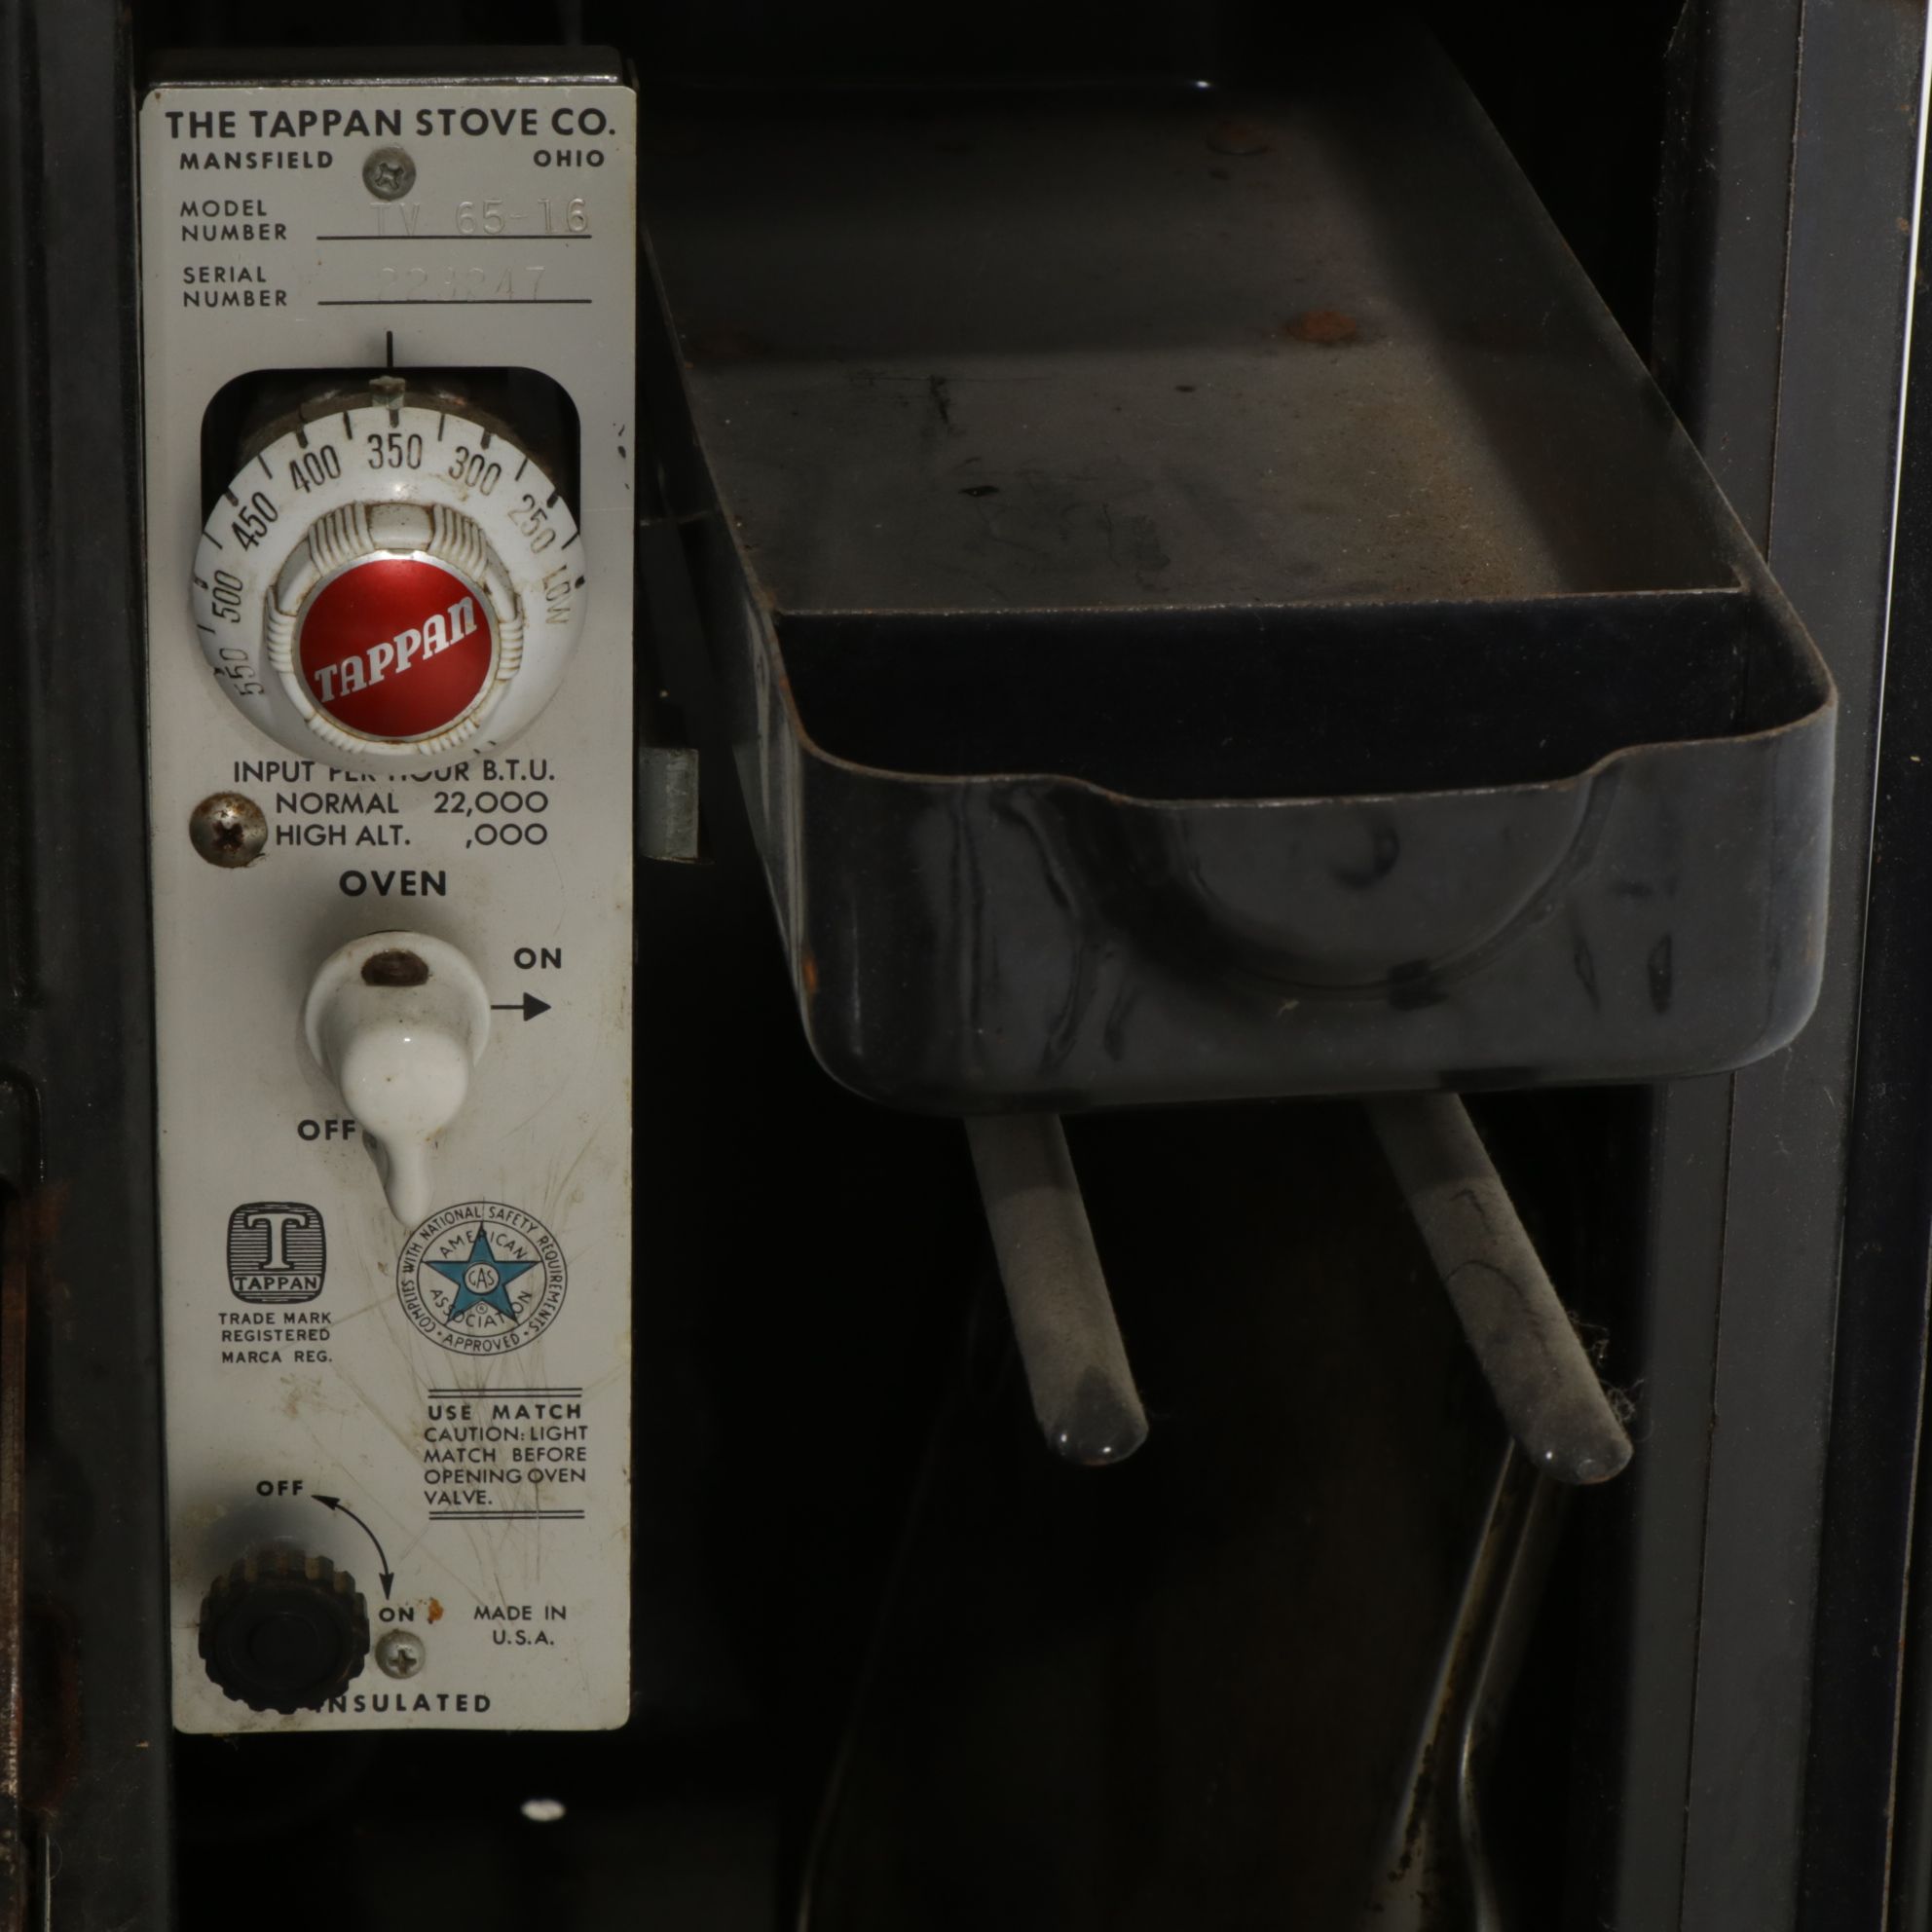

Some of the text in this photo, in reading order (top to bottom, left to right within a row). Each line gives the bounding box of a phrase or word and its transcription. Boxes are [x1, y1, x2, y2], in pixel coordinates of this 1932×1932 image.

[165, 107, 615, 139] THE TAPPAN STOVE CO.
[179, 149, 605, 170] MANSFIELD OHIO
[179, 199, 267, 218] MODEL
[181, 198, 590, 242] NUMBER TV 65-16
[183, 266, 267, 284] SERIAL
[183, 289, 287, 308] NUMBER
[367, 433, 423, 470] 350
[291, 444, 342, 495] 400
[448, 445, 502, 497] 300
[230, 491, 279, 552] 450
[508, 494, 557, 554] 250
[212, 570, 243, 623] 500
[542, 565, 573, 625] LOW
[315, 596, 477, 704] TAPPAN
[219, 648, 264, 696] 550
[234, 760, 316, 783] INPUT
[389, 761, 469, 783] UR
[483, 759, 555, 781] B.T.U.
[276, 791, 549, 818] NORMAL 22,000
[276, 823, 548, 849] HIGH ALT. ,000
[339, 870, 446, 898] OVEN
[513, 947, 562, 970] ON
[297, 1118, 356, 1141] OFF
[401, 1206, 563, 1333] COMPLIES WITH NATIONAL SAFETY REQUIREMENTS
[234, 1277, 316, 1291] TAPPAN
[218, 1312, 331, 1325] TRADE MARK
[429, 1290, 533, 1328] ASSOCIATON
[221, 1327, 330, 1343] REGISTERED
[442, 1333, 520, 1352] APPROVED
[221, 1350, 332, 1364] MARCA REG.
[427, 1403, 581, 1421] USE MATCH
[422, 1425, 590, 1444] CAUTION: LIGHT
[423, 1445, 588, 1465] MATCH BEFORE
[423, 1467, 587, 1486] OPENING OVEN
[255, 1480, 303, 1498] OFF
[423, 1489, 495, 1507] VALVE.
[378, 1607, 415, 1623] ON
[473, 1605, 567, 1621] MADE IN
[493, 1629, 554, 1646] U.S.A.
[315, 1693, 493, 1714] NSULATED
